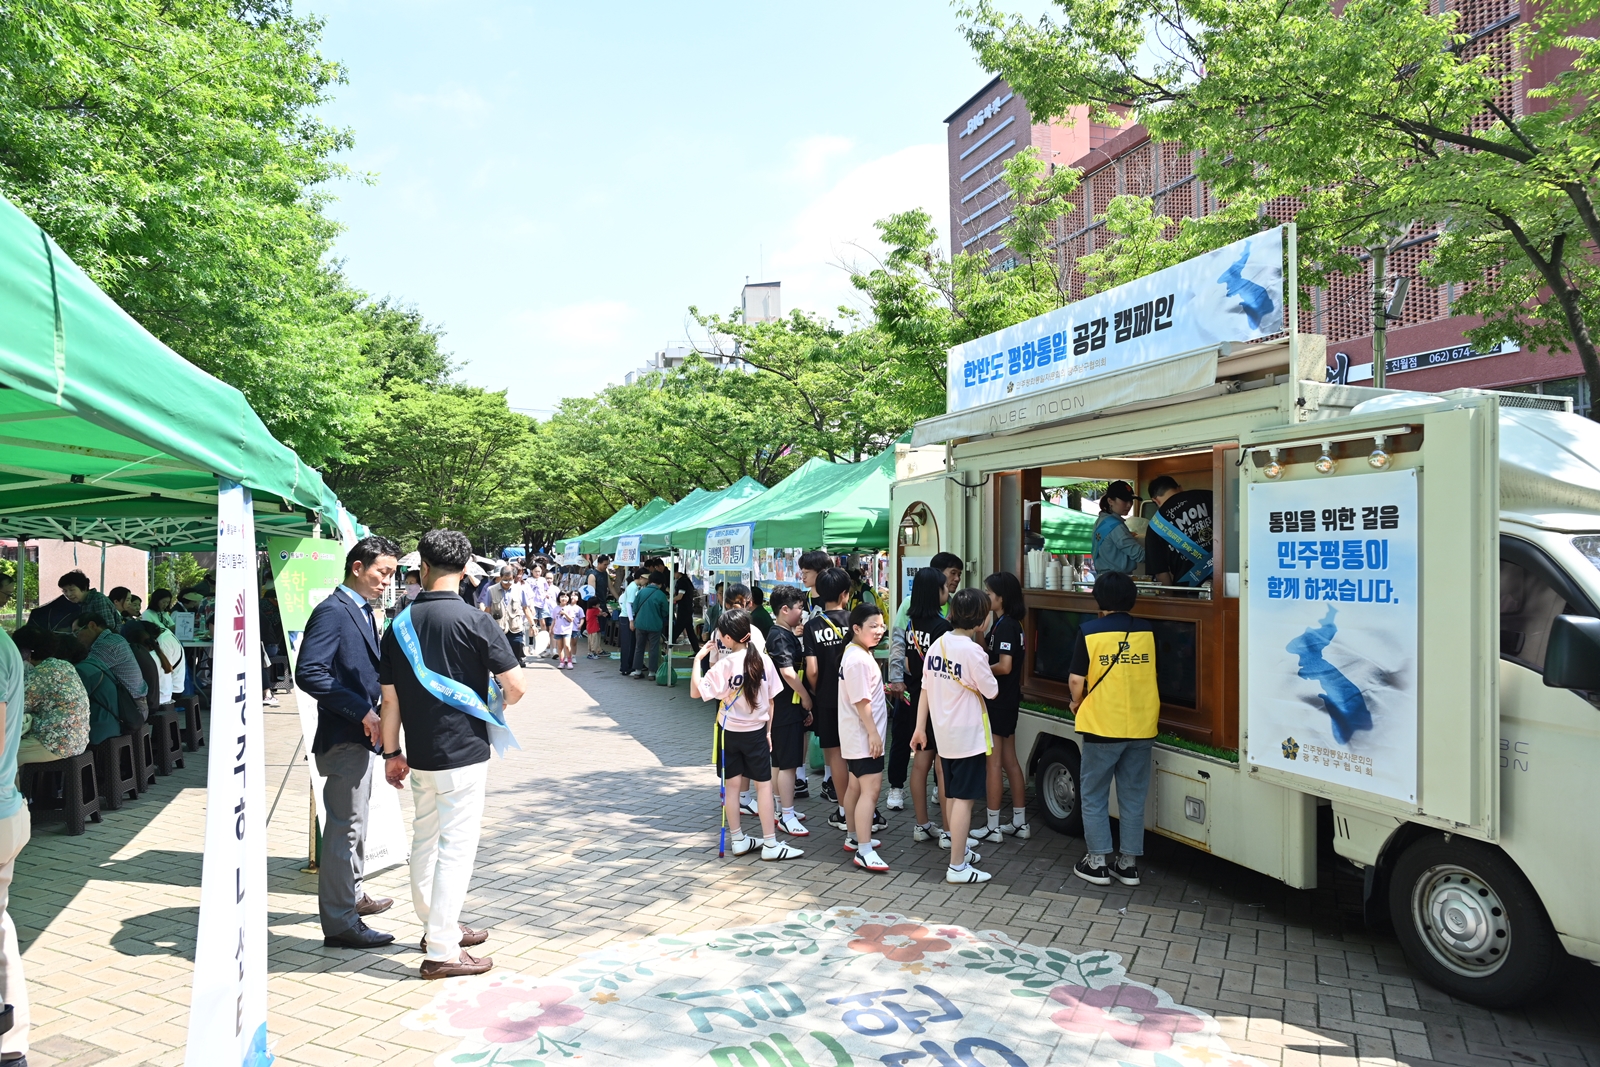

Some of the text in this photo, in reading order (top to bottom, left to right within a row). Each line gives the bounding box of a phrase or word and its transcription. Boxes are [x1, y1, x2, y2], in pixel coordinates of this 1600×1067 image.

[963, 294, 1175, 387] 한반도 평화통일 공감 캠페인
[1391, 342, 1499, 371] 진월점 062) 674-2
[1036, 395, 1085, 416] MOON
[1269, 505, 1399, 533] 통일을 위한 걸음
[1278, 539, 1388, 570] 민주평통이
[280, 571, 307, 592] 북한
[1268, 576, 1399, 604] 함께 하겠습니다.
[284, 592, 304, 613] 음식
[1303, 743, 1373, 767] 민주평화통일자문회의
